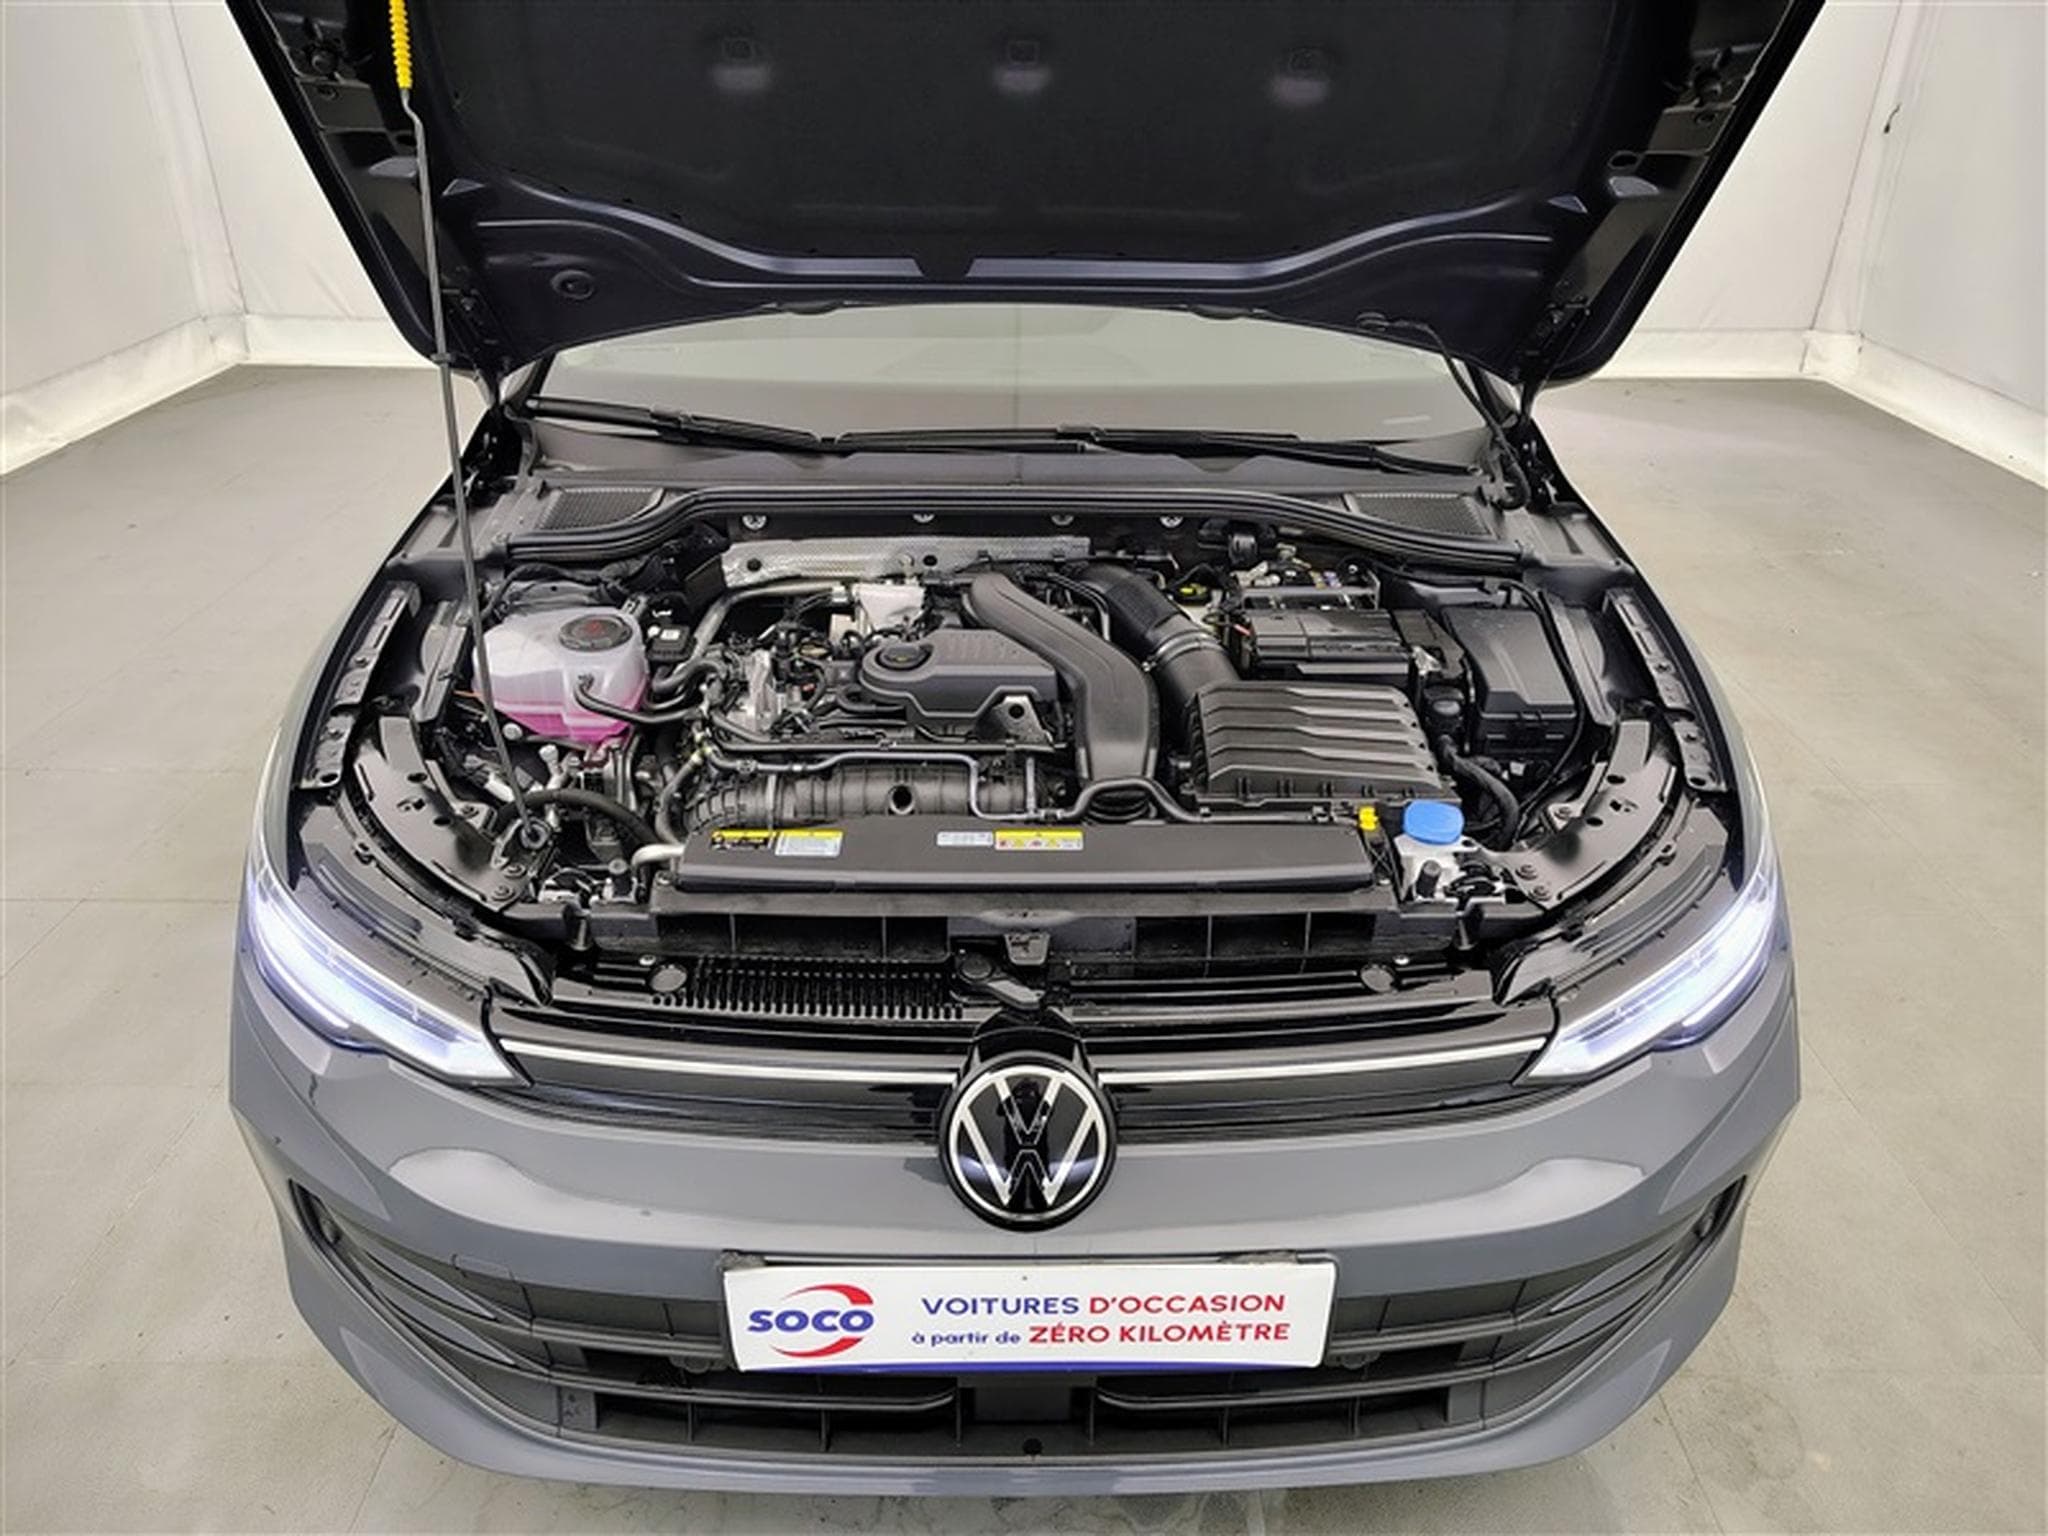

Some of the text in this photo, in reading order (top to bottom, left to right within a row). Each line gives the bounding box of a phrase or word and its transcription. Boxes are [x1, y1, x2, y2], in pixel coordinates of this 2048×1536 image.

[921, 1294, 1285, 1315] VOITURES D'OCCASION
[748, 1309, 874, 1333] SOCO
[911, 1319, 1291, 1347] à partir de ZÉRO KILOMÈTRE
